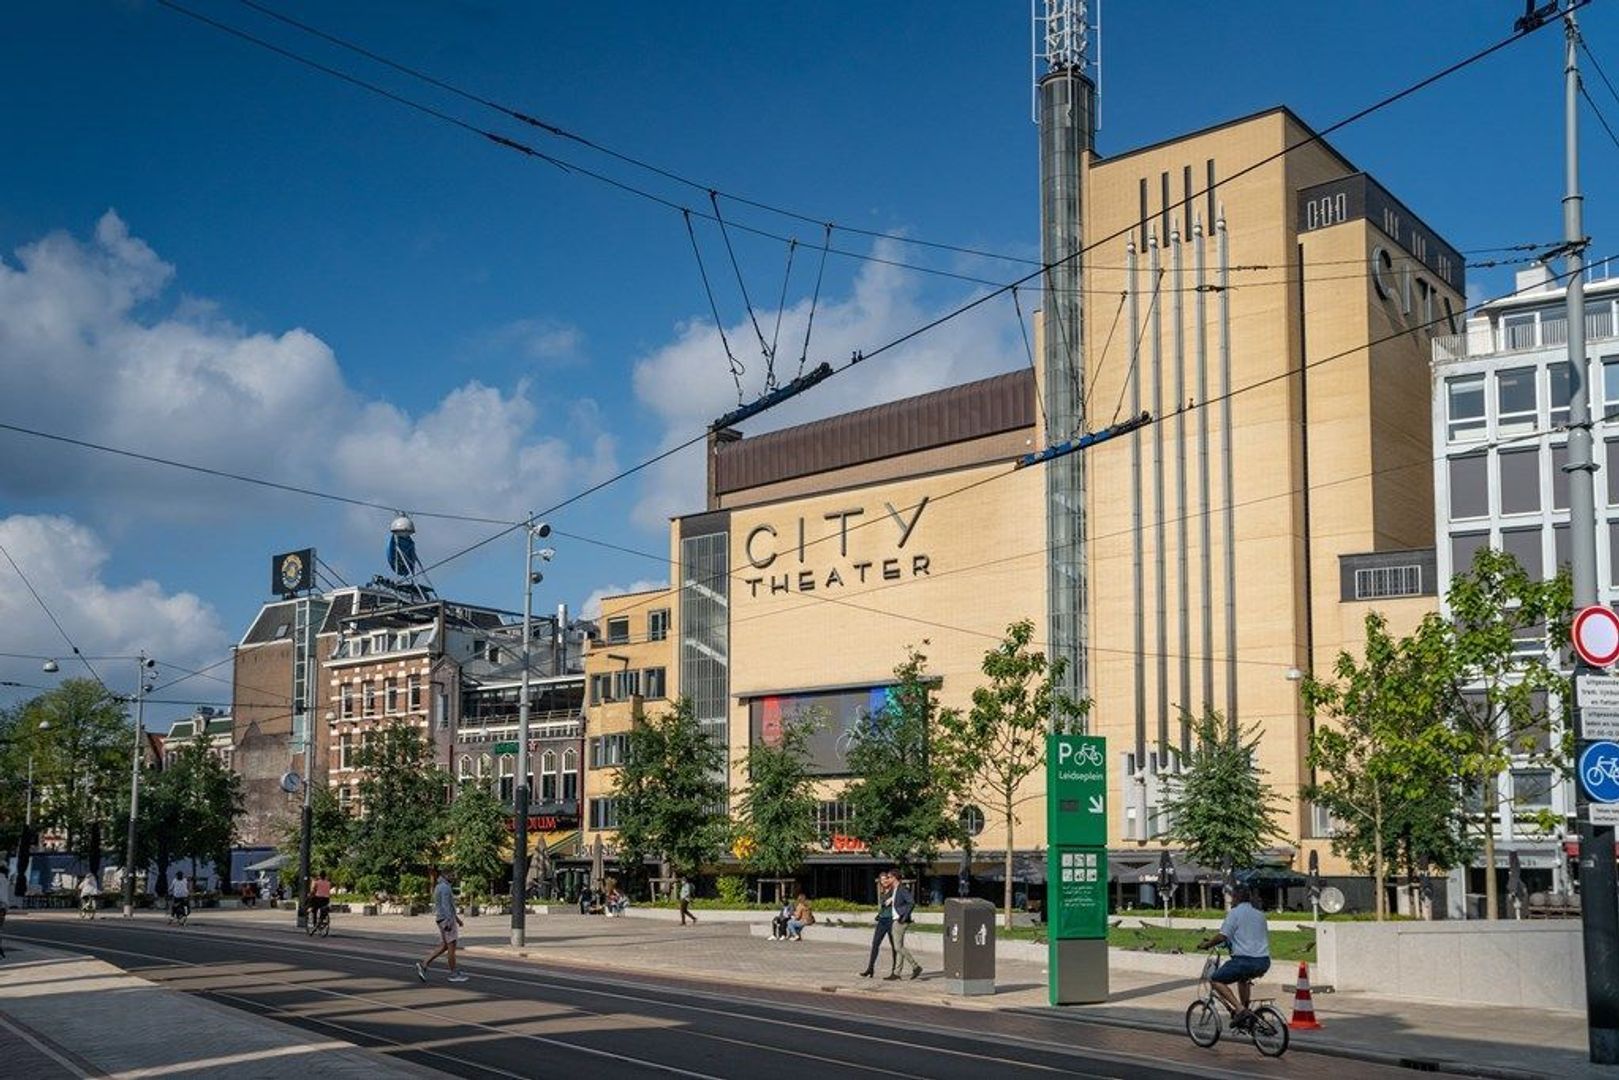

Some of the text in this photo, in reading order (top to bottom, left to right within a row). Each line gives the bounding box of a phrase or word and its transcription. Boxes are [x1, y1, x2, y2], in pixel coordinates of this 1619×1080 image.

[745, 496, 929, 569] CITY
[745, 554, 930, 598] THEATER
[1059, 742, 1072, 765] P
[1059, 770, 1104, 782] Leidseplein
